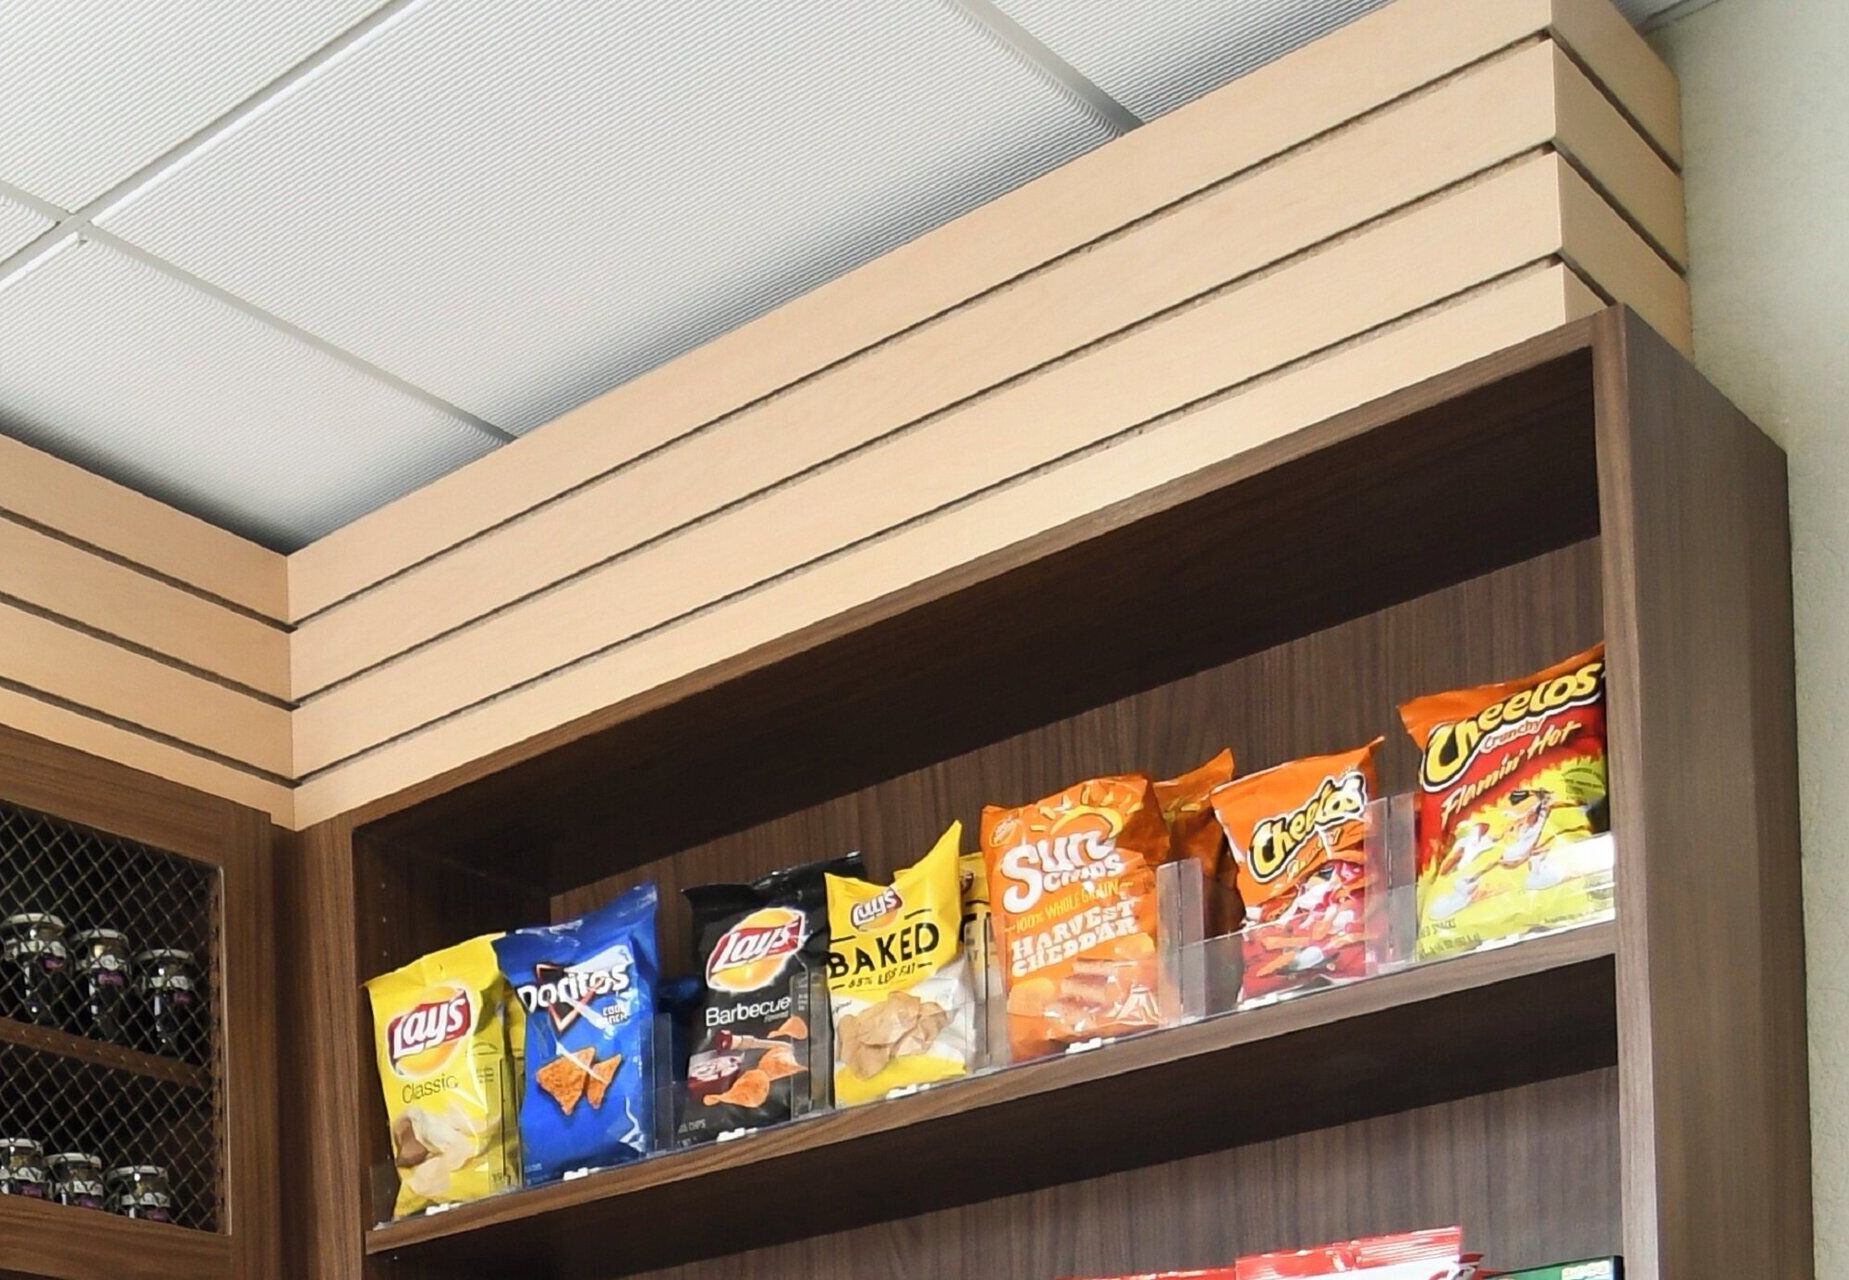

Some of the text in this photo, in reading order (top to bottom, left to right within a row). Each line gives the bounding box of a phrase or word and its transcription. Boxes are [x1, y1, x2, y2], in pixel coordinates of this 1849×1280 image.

[1424, 661, 1602, 788] Cheetos
[1527, 720, 1582, 760] Hot
[1251, 774, 1366, 881] Cheetos
[1002, 830, 1116, 913] Sun
[827, 922, 939, 979] BAKED
[1012, 898, 1135, 962] HARVEST
[1012, 917, 1138, 977] CHEDDAR
[517, 964, 629, 1013] Doritos
[705, 996, 790, 1028] Barbecue
[402, 1073, 459, 1104] Classic
